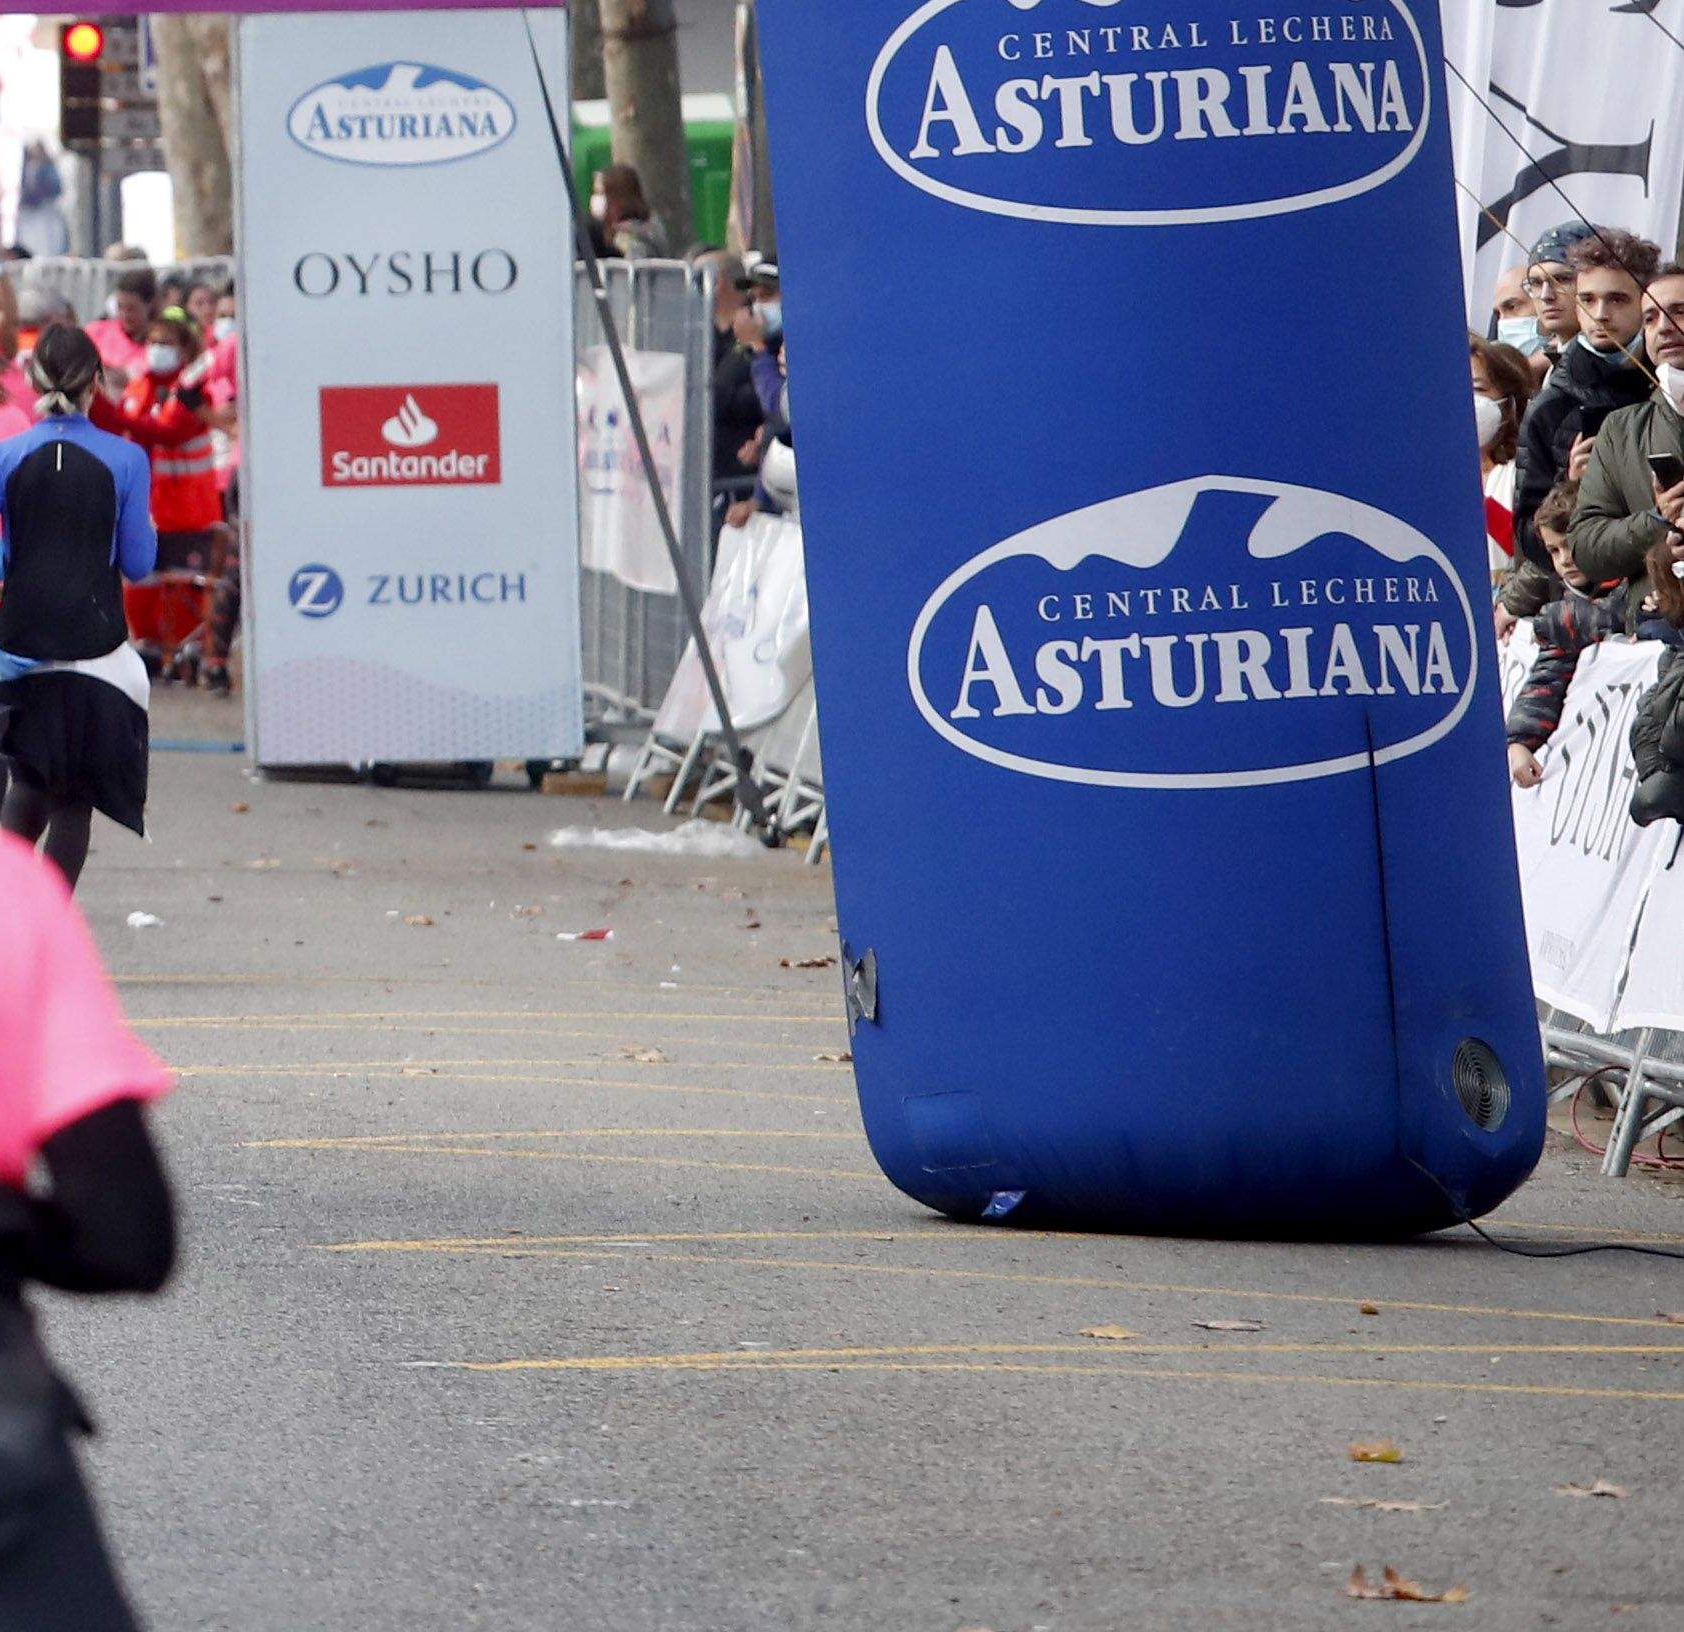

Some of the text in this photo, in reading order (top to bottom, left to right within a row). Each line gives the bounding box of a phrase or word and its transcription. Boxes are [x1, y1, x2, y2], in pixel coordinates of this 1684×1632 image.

[998, 14, 1396, 62] CENTRAL LECHERA
[306, 102, 499, 140] ASTURIANA
[909, 44, 1414, 160] ASTURIANA
[292, 248, 520, 299] OYSHO
[332, 449, 490, 483] Santander
[366, 570, 528, 606] ZURICH
[1038, 575, 1441, 624] CENTRAL LECHERA
[950, 603, 1461, 720] ASTURIANA
